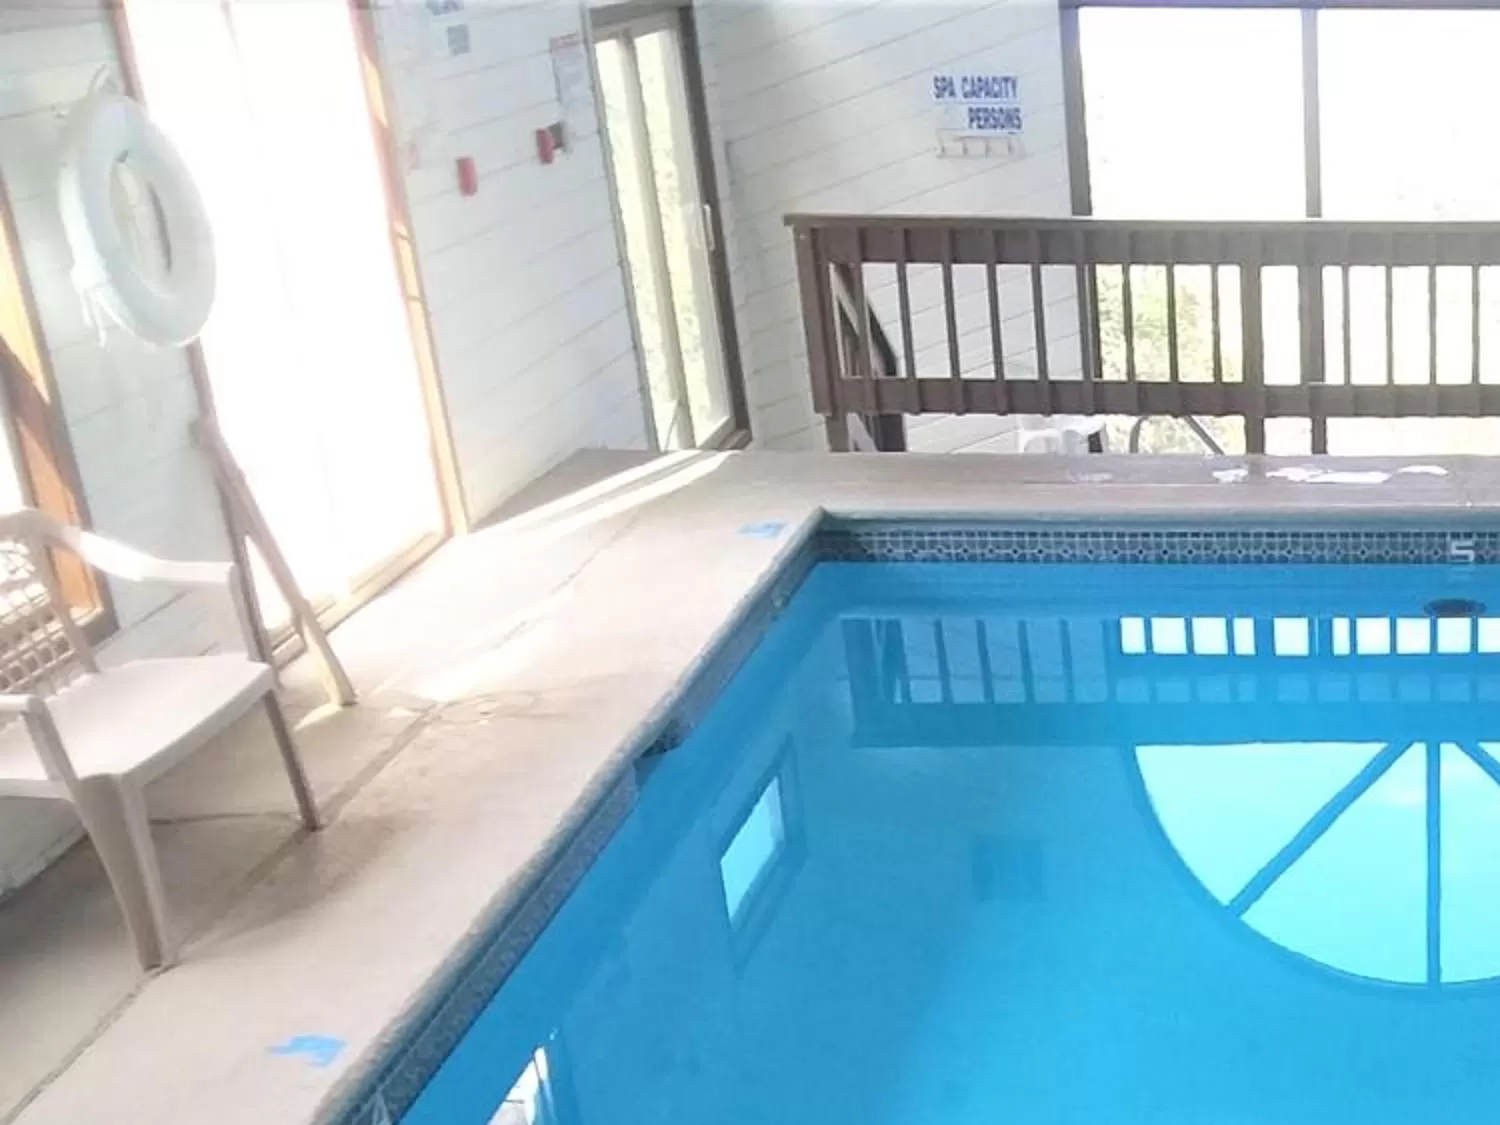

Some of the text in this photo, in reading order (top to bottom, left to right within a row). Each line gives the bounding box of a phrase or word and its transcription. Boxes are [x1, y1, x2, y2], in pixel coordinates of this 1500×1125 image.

[933, 75, 1018, 99] SPA CAPACITY
[967, 106, 1022, 130] PERSONS
[1451, 540, 1476, 562] 5
